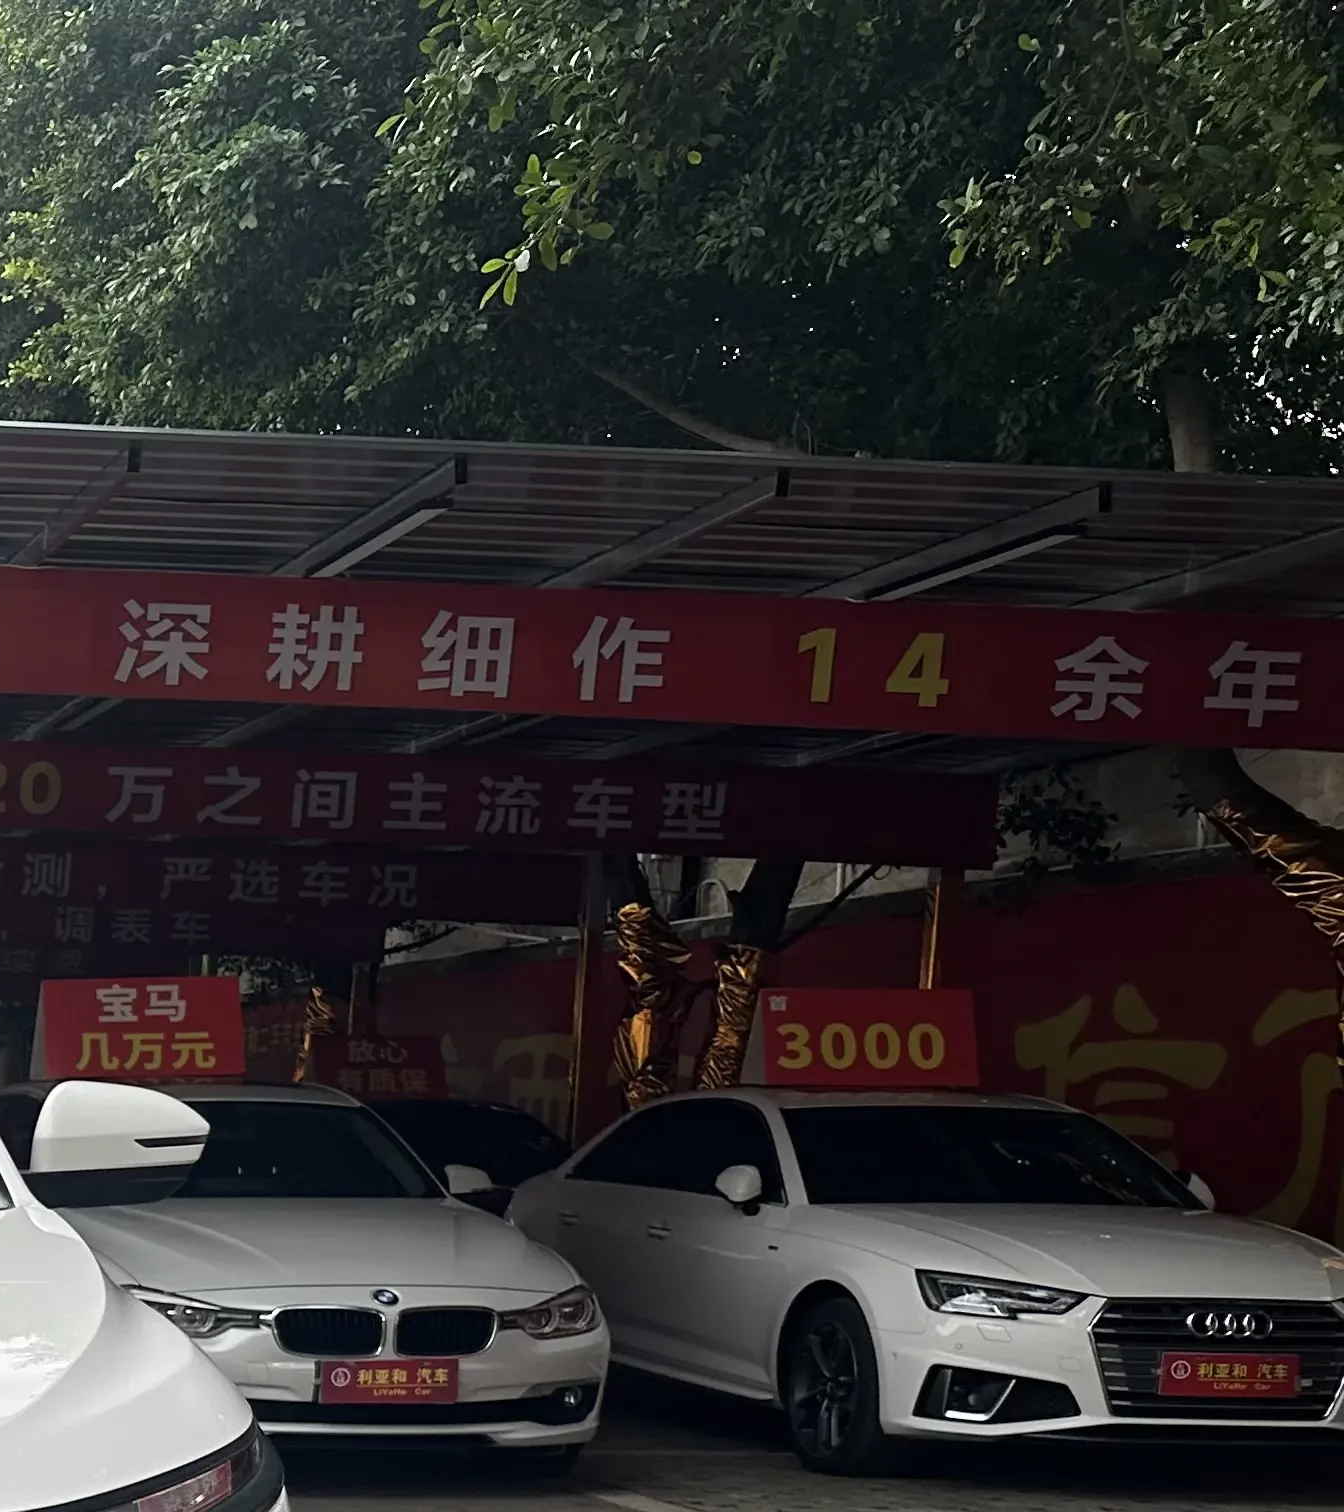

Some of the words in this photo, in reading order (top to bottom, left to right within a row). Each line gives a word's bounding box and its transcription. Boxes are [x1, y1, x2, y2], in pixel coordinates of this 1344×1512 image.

[95, 983, 188, 1024] 宝马
[75, 1031, 218, 1072] 几万元
[346, 1038, 409, 1064] 放心
[776, 1021, 946, 1071] 3000
[336, 1067, 430, 1094] 有质保
[356, 1368, 408, 1386] 利亚和
[416, 1367, 449, 1385] 汽车
[1196, 1363, 1248, 1379] 利亚和
[1256, 1363, 1289, 1379] 汽车
